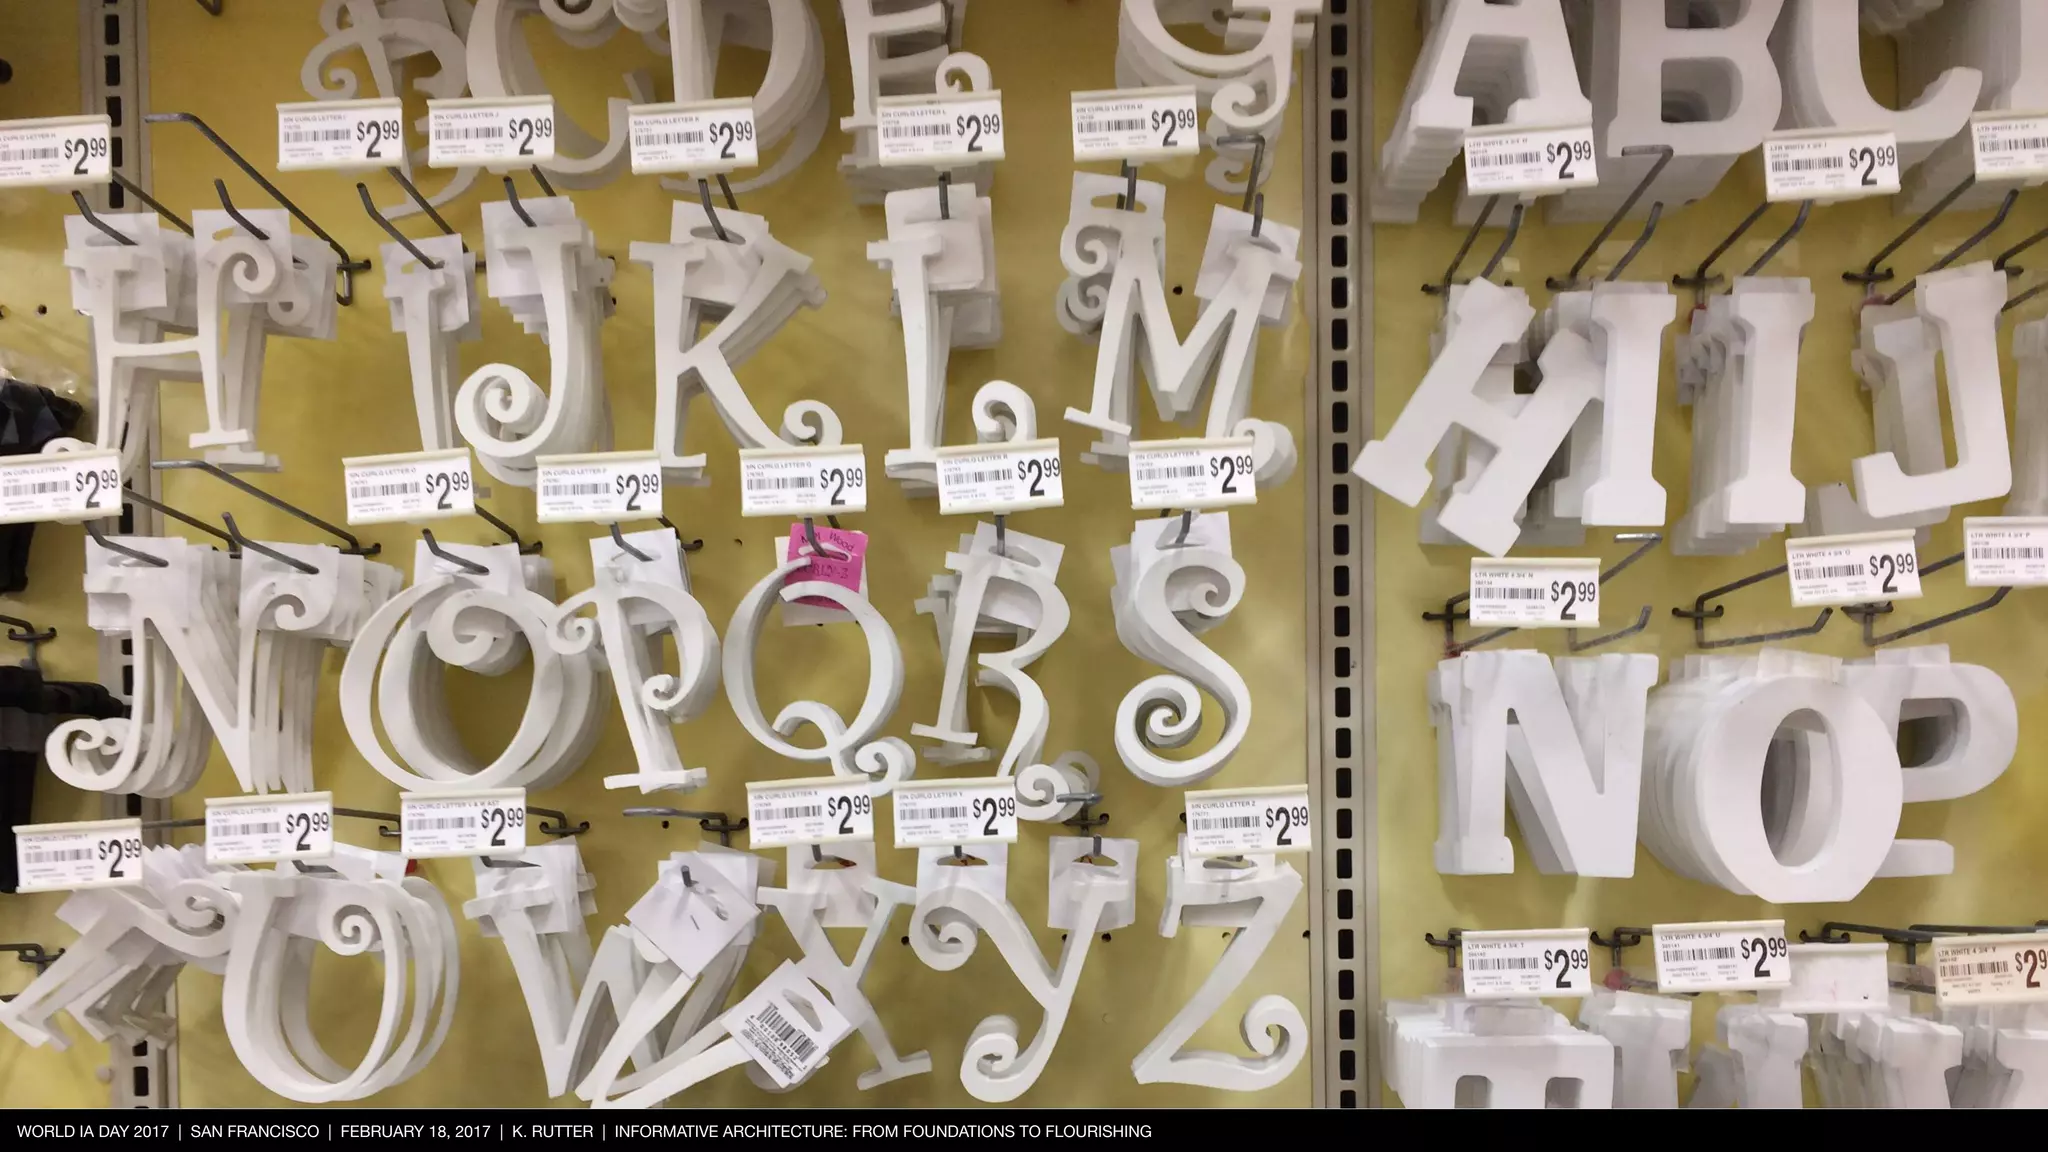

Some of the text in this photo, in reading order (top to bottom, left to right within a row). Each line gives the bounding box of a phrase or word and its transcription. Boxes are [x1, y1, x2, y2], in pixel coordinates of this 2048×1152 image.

[1111, 103, 1136, 111] LETTER
[469, 111, 493, 119] LETTER
[916, 108, 941, 116] LETTER
[669, 116, 693, 124] LETTER
[1482, 139, 1502, 147] WHITE
[1170, 450, 1194, 458] LETTER
[977, 454, 1001, 463] LETTER
[780, 461, 805, 469] LETTER
[385, 467, 409, 476] LETTER
[576, 467, 601, 475] LETTER
[1805, 550, 1825, 559] WHITE
[788, 790, 812, 798] LETTER
[933, 791, 957, 799] LETTER
[1226, 800, 1250, 808] LETTER
[1673, 933, 1694, 941] WHITE
[1950, 947, 1970, 956] WHITE
